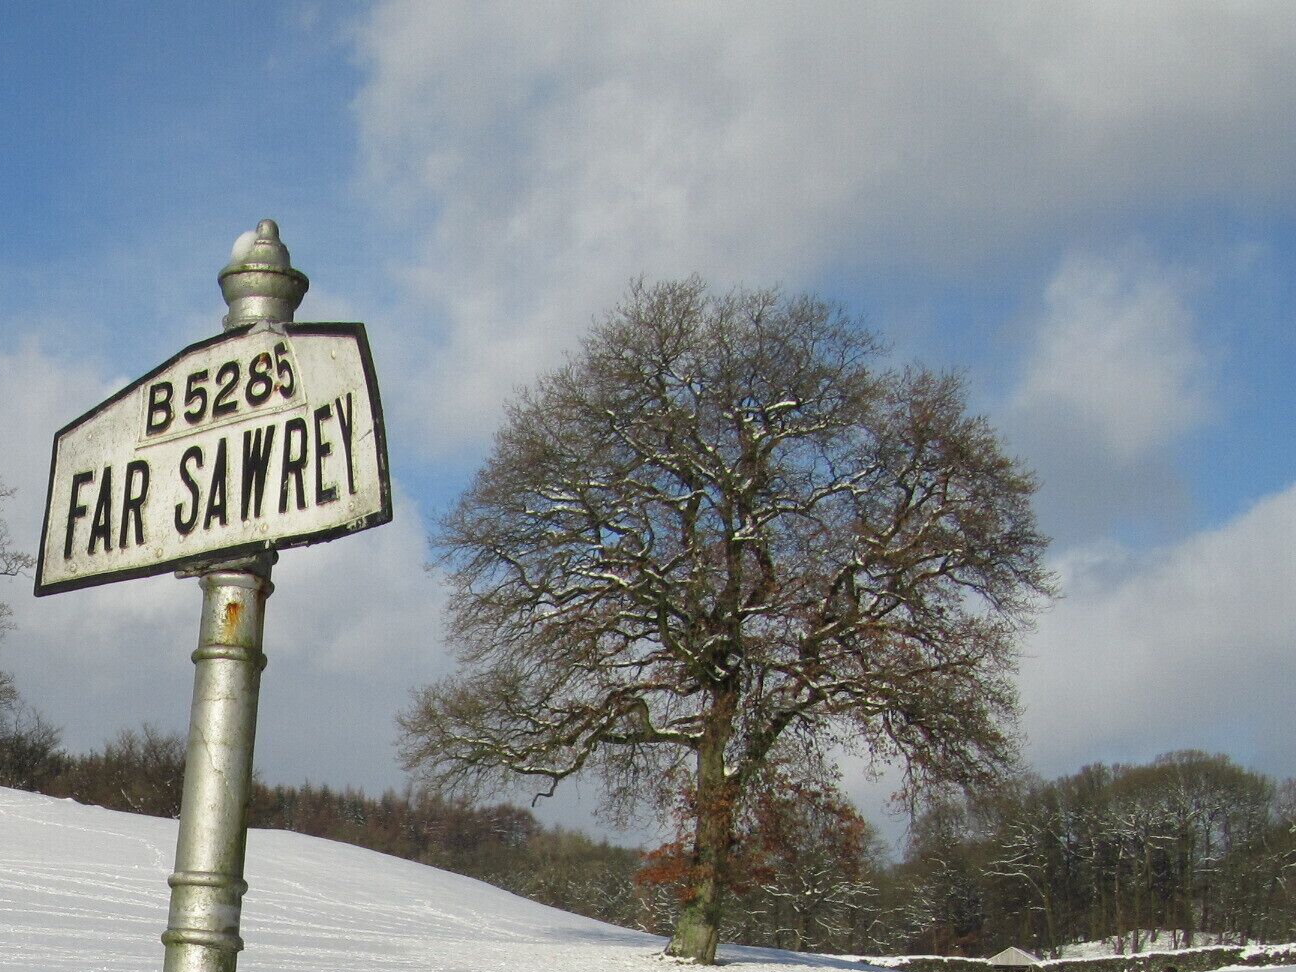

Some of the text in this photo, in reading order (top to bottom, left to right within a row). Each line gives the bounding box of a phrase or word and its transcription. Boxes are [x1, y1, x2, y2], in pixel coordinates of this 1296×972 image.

[145, 342, 295, 436] B5285
[64, 392, 357, 560] FAR SAWREY
